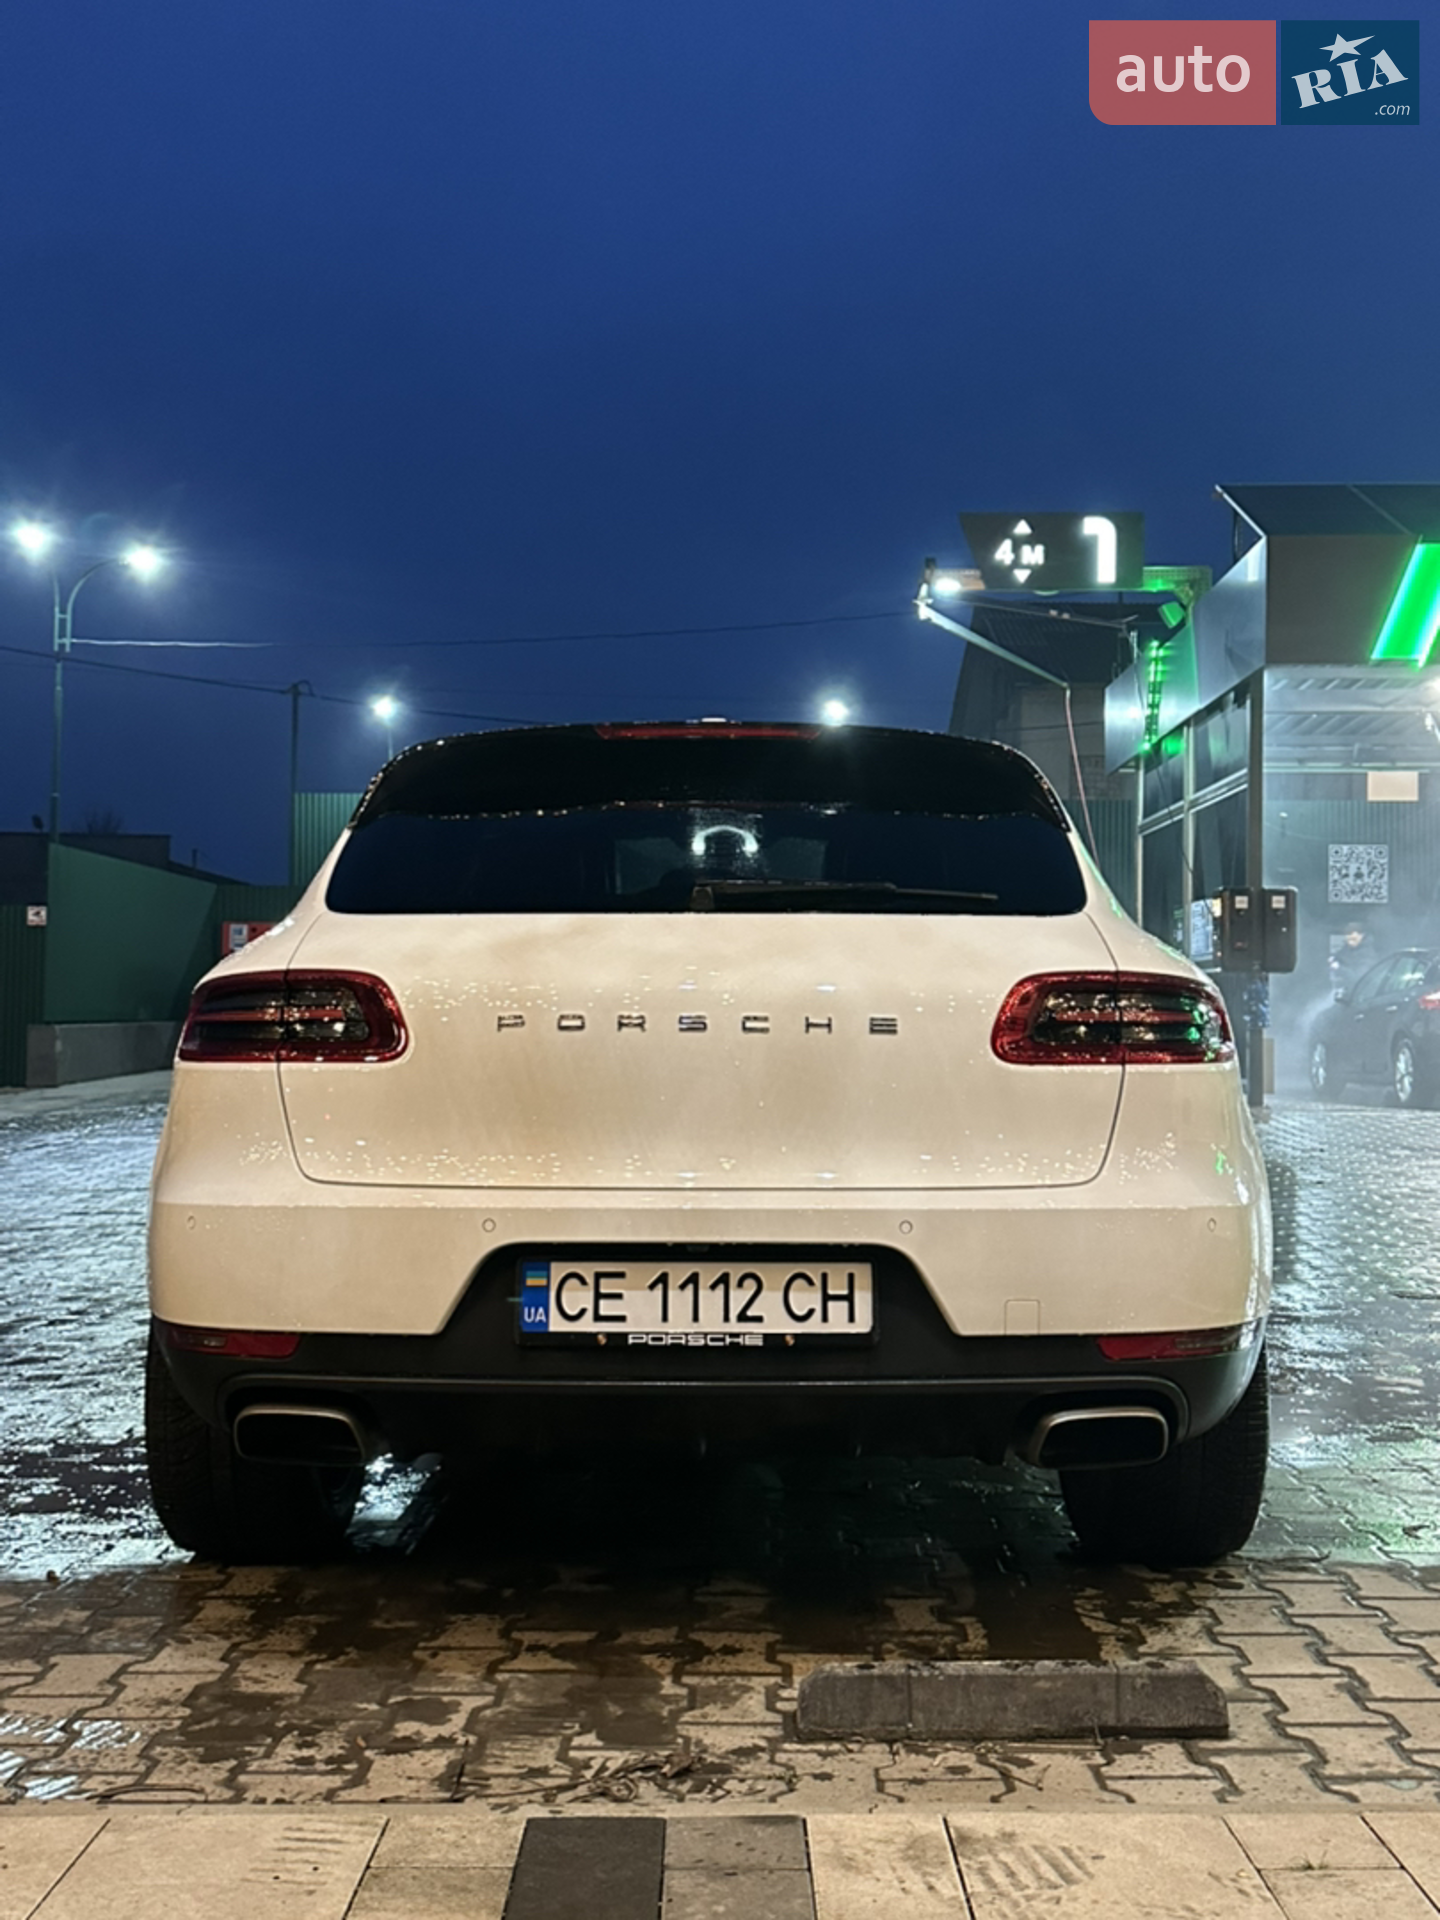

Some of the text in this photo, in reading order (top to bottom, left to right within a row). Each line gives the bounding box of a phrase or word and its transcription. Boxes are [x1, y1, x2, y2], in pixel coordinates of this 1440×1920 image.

[994, 538, 1016, 566] 4
[1082, 515, 1117, 584] 1
[496, 1013, 899, 1036] PORSCHE
[555, 1270, 855, 1324] CE 1112 CH
[523, 1306, 547, 1323] UA
[627, 1333, 764, 1347] PORSCHE
